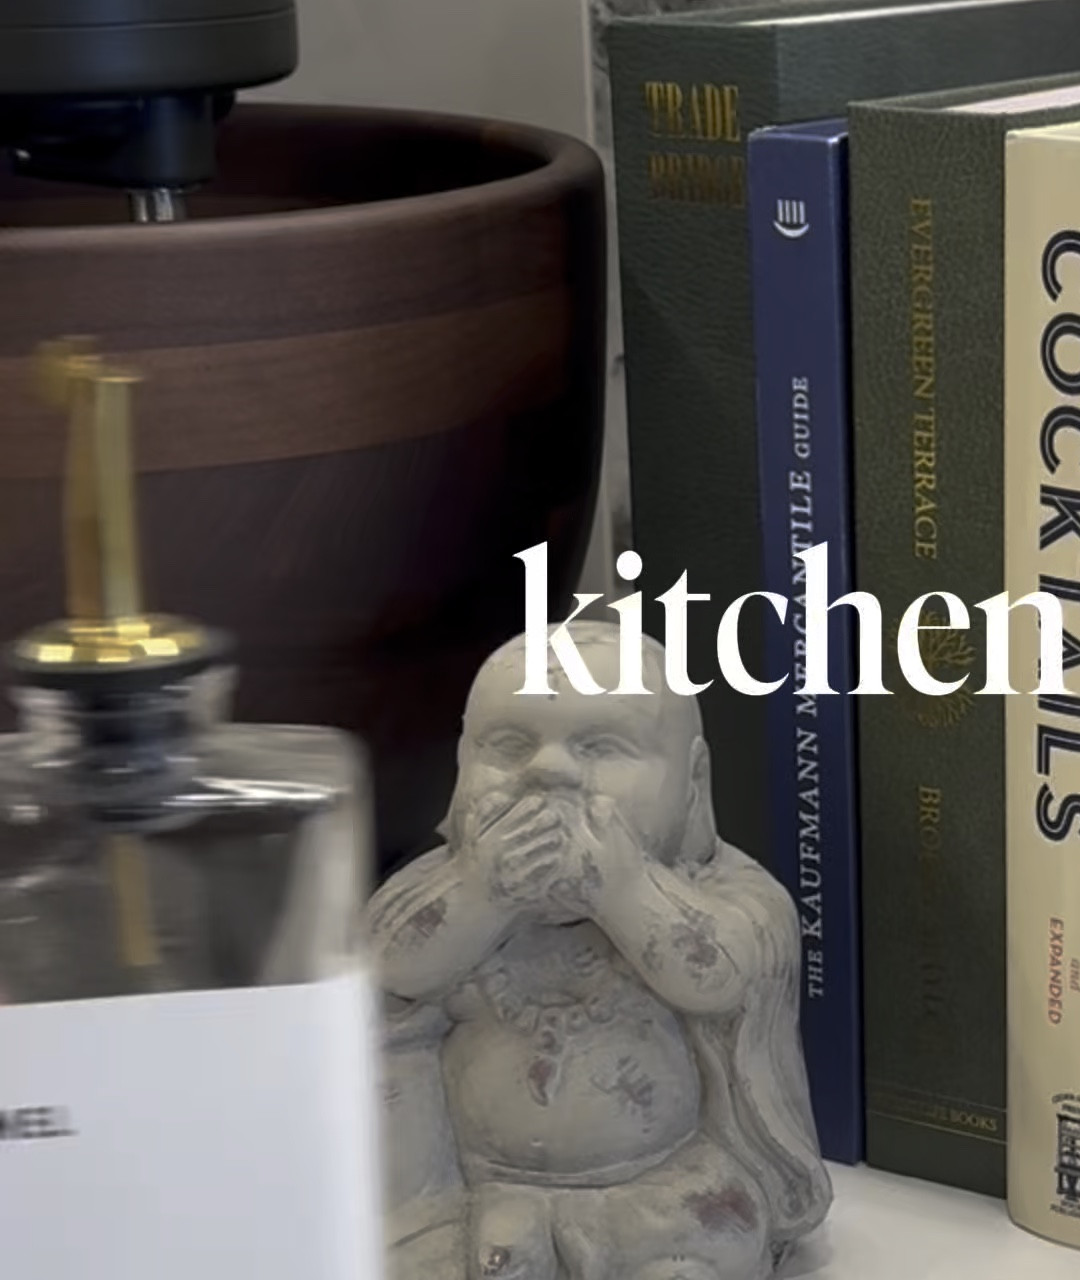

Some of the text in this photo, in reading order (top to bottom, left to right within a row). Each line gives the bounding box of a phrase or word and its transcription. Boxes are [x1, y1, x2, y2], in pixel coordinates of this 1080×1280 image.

[644, 81, 741, 142] TRADE
[791, 376, 811, 459] GUIDE
[910, 197, 938, 560] EVERGREEN TERRACE
[795, 727, 823, 939] KAUFMANN
[807, 949, 824, 998] THE
[1047, 916, 1064, 1025] EXPANDED
